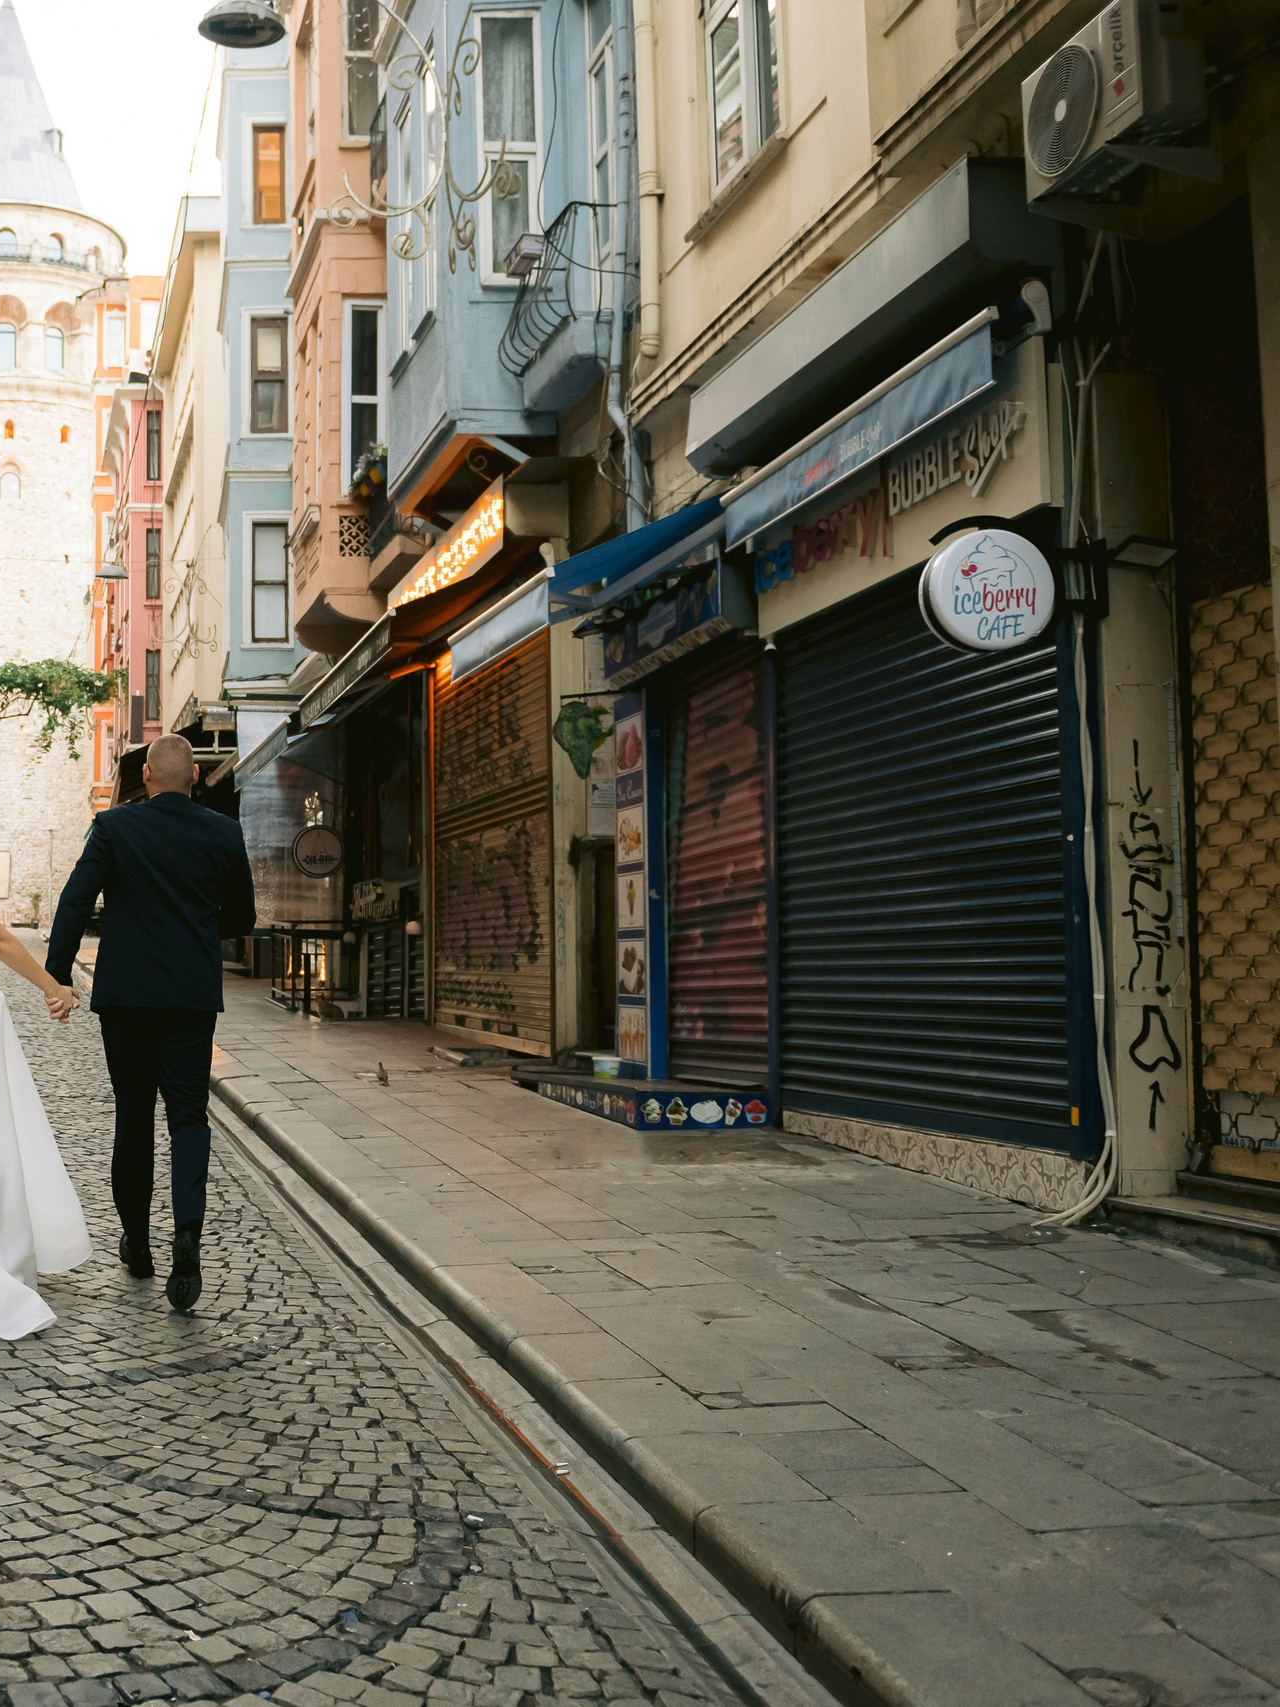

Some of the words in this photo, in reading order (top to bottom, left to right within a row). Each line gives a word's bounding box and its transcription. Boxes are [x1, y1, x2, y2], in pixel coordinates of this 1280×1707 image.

[1109, 6, 1125, 73] arçelik
[888, 429, 962, 516] BUBBLE
[953, 583, 1037, 616] iceberry
[976, 613, 1025, 641] CAFE
